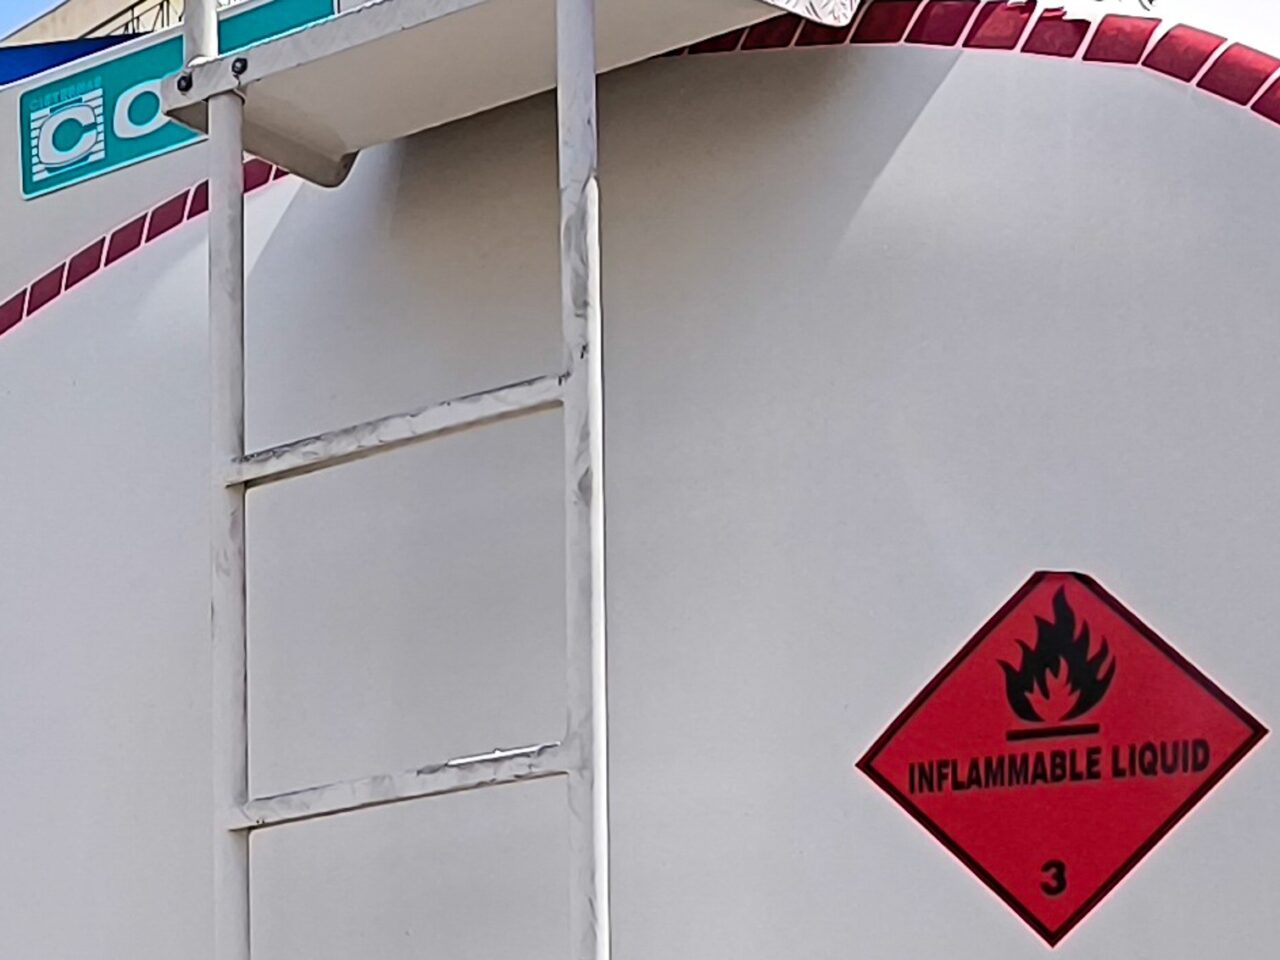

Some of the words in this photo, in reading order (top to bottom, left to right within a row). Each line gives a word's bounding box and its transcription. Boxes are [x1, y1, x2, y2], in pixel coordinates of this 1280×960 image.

[908, 747, 1102, 794] INFLAMMABLE
[1112, 739, 1210, 778] LIQUID
[1040, 860, 1067, 896] 3
